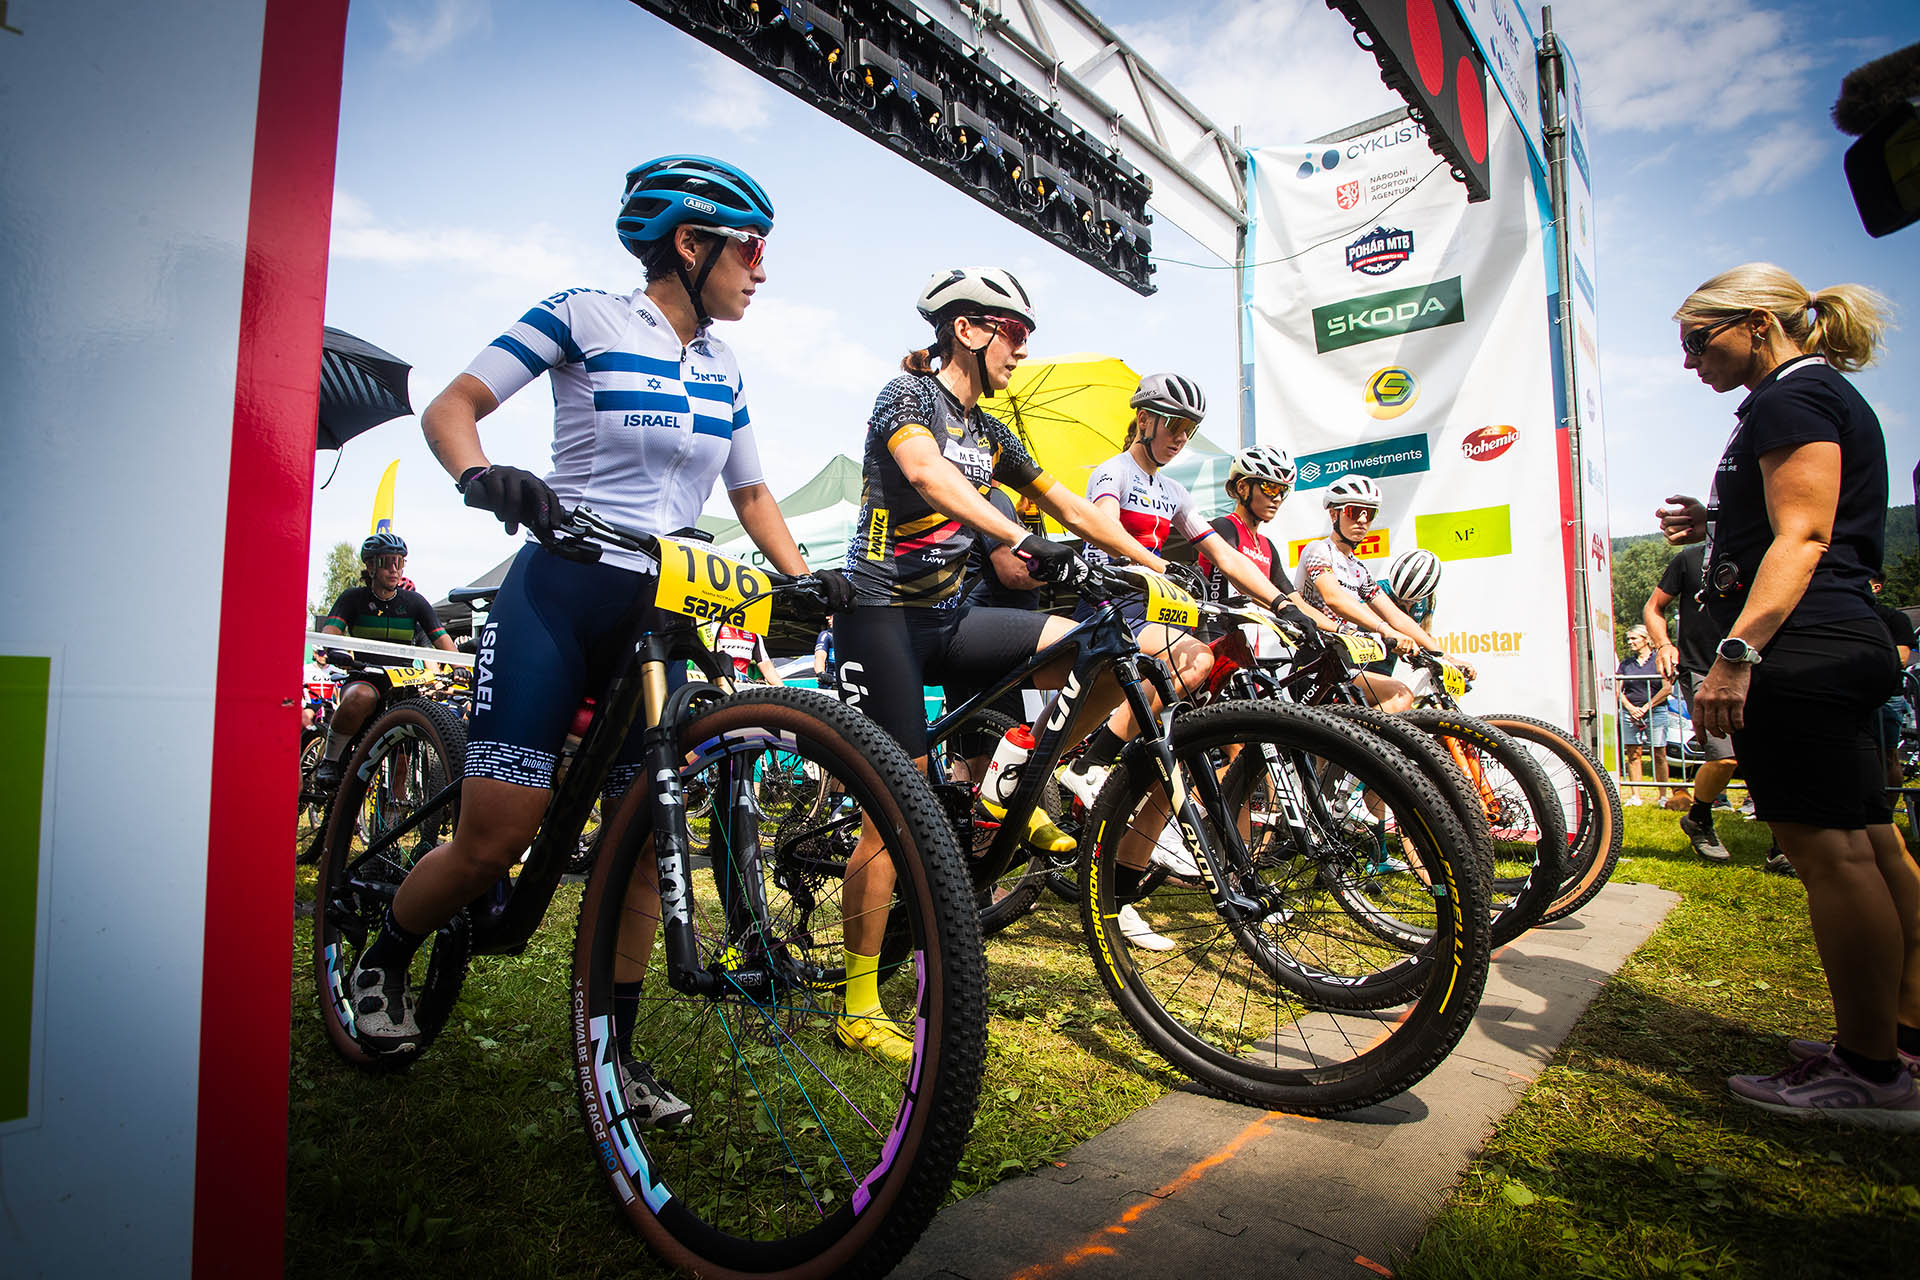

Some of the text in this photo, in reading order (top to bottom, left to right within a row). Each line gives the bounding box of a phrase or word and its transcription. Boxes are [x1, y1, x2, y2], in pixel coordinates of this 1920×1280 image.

[1371, 175, 1418, 192] SPORTOVNÍ
[687, 200, 713, 212] ABUS
[1348, 235, 1410, 261] POHÁR MTB
[691, 366, 727, 382] ישראל
[623, 414, 681, 428] ISRAEL
[1462, 430, 1520, 458] Bohemia
[1325, 449, 1423, 474] ZDR Investments
[870, 512, 886, 558] MAVIC
[678, 545, 759, 601] 106
[1158, 608, 1188, 624] sazka
[475, 622, 499, 717] ISRAEL
[1438, 720, 1499, 748] MAXXIS
[660, 853, 690, 928] FOX
[1090, 861, 1114, 966] SCORPION
[1440, 858, 1464, 967] PIRELLI
[574, 991, 618, 1171] SCHWALBE RICK RACE PRO
